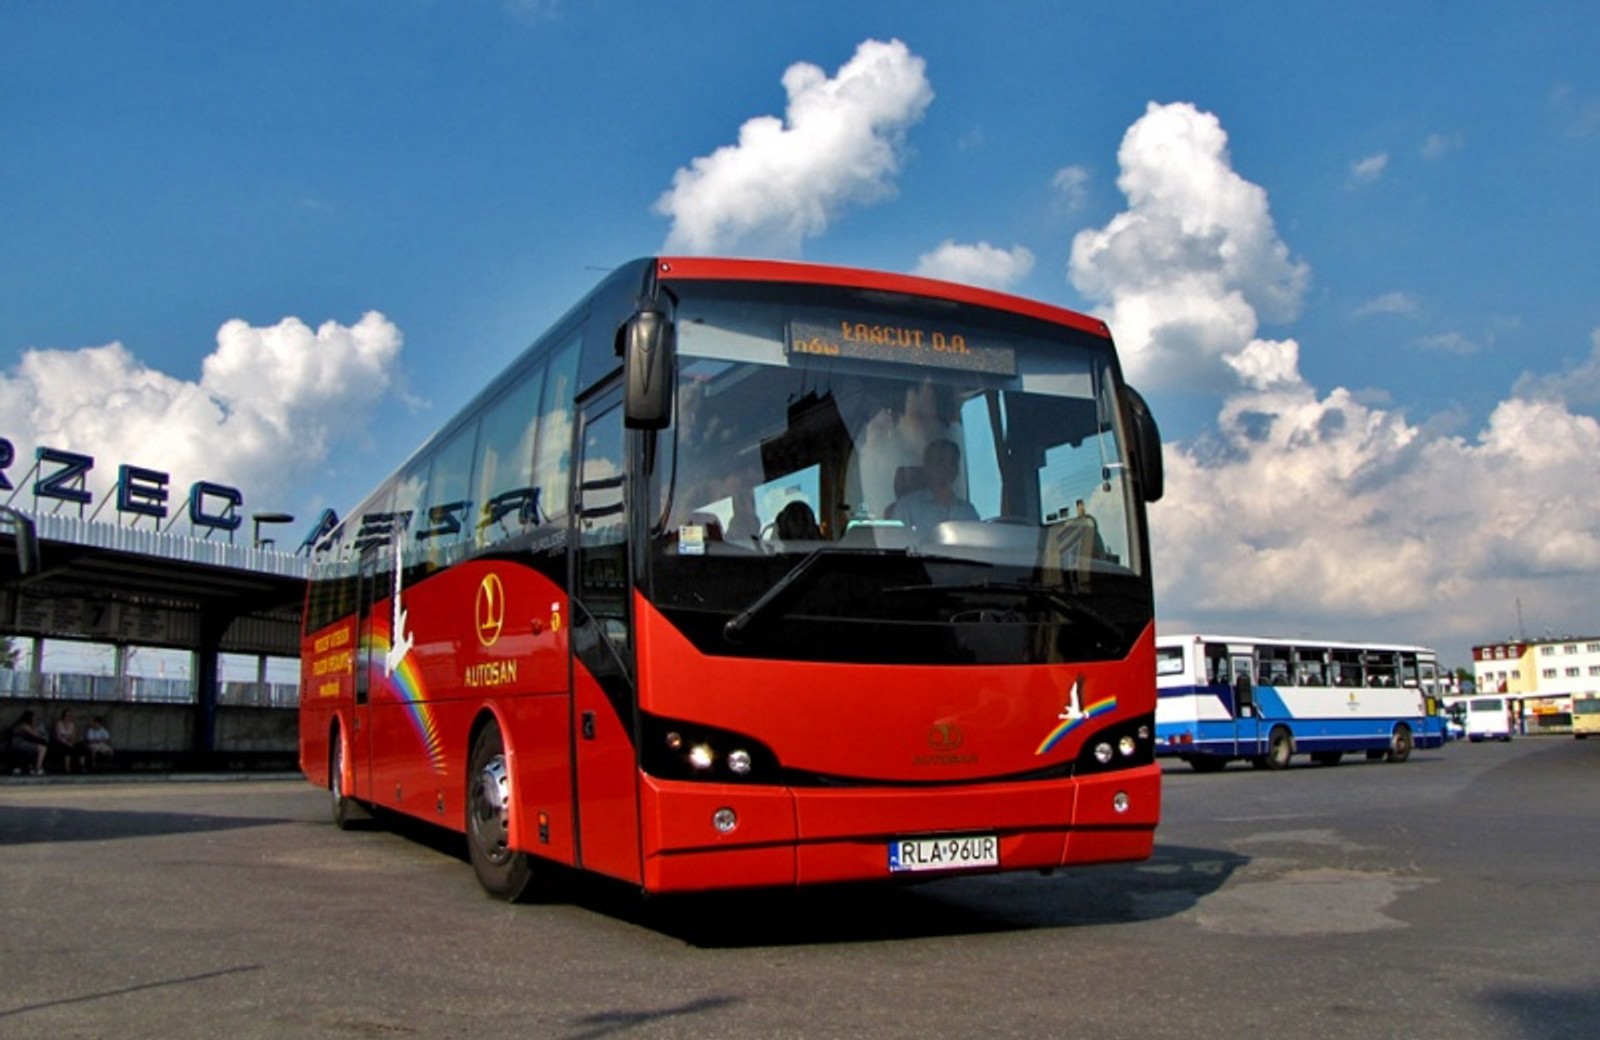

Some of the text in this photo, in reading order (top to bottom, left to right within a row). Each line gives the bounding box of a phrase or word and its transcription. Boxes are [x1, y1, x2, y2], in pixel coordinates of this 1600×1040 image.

[464, 658, 518, 687] AUTOSAN
[901, 841, 943, 864] RLA
[948, 837, 995, 861] 96UR
